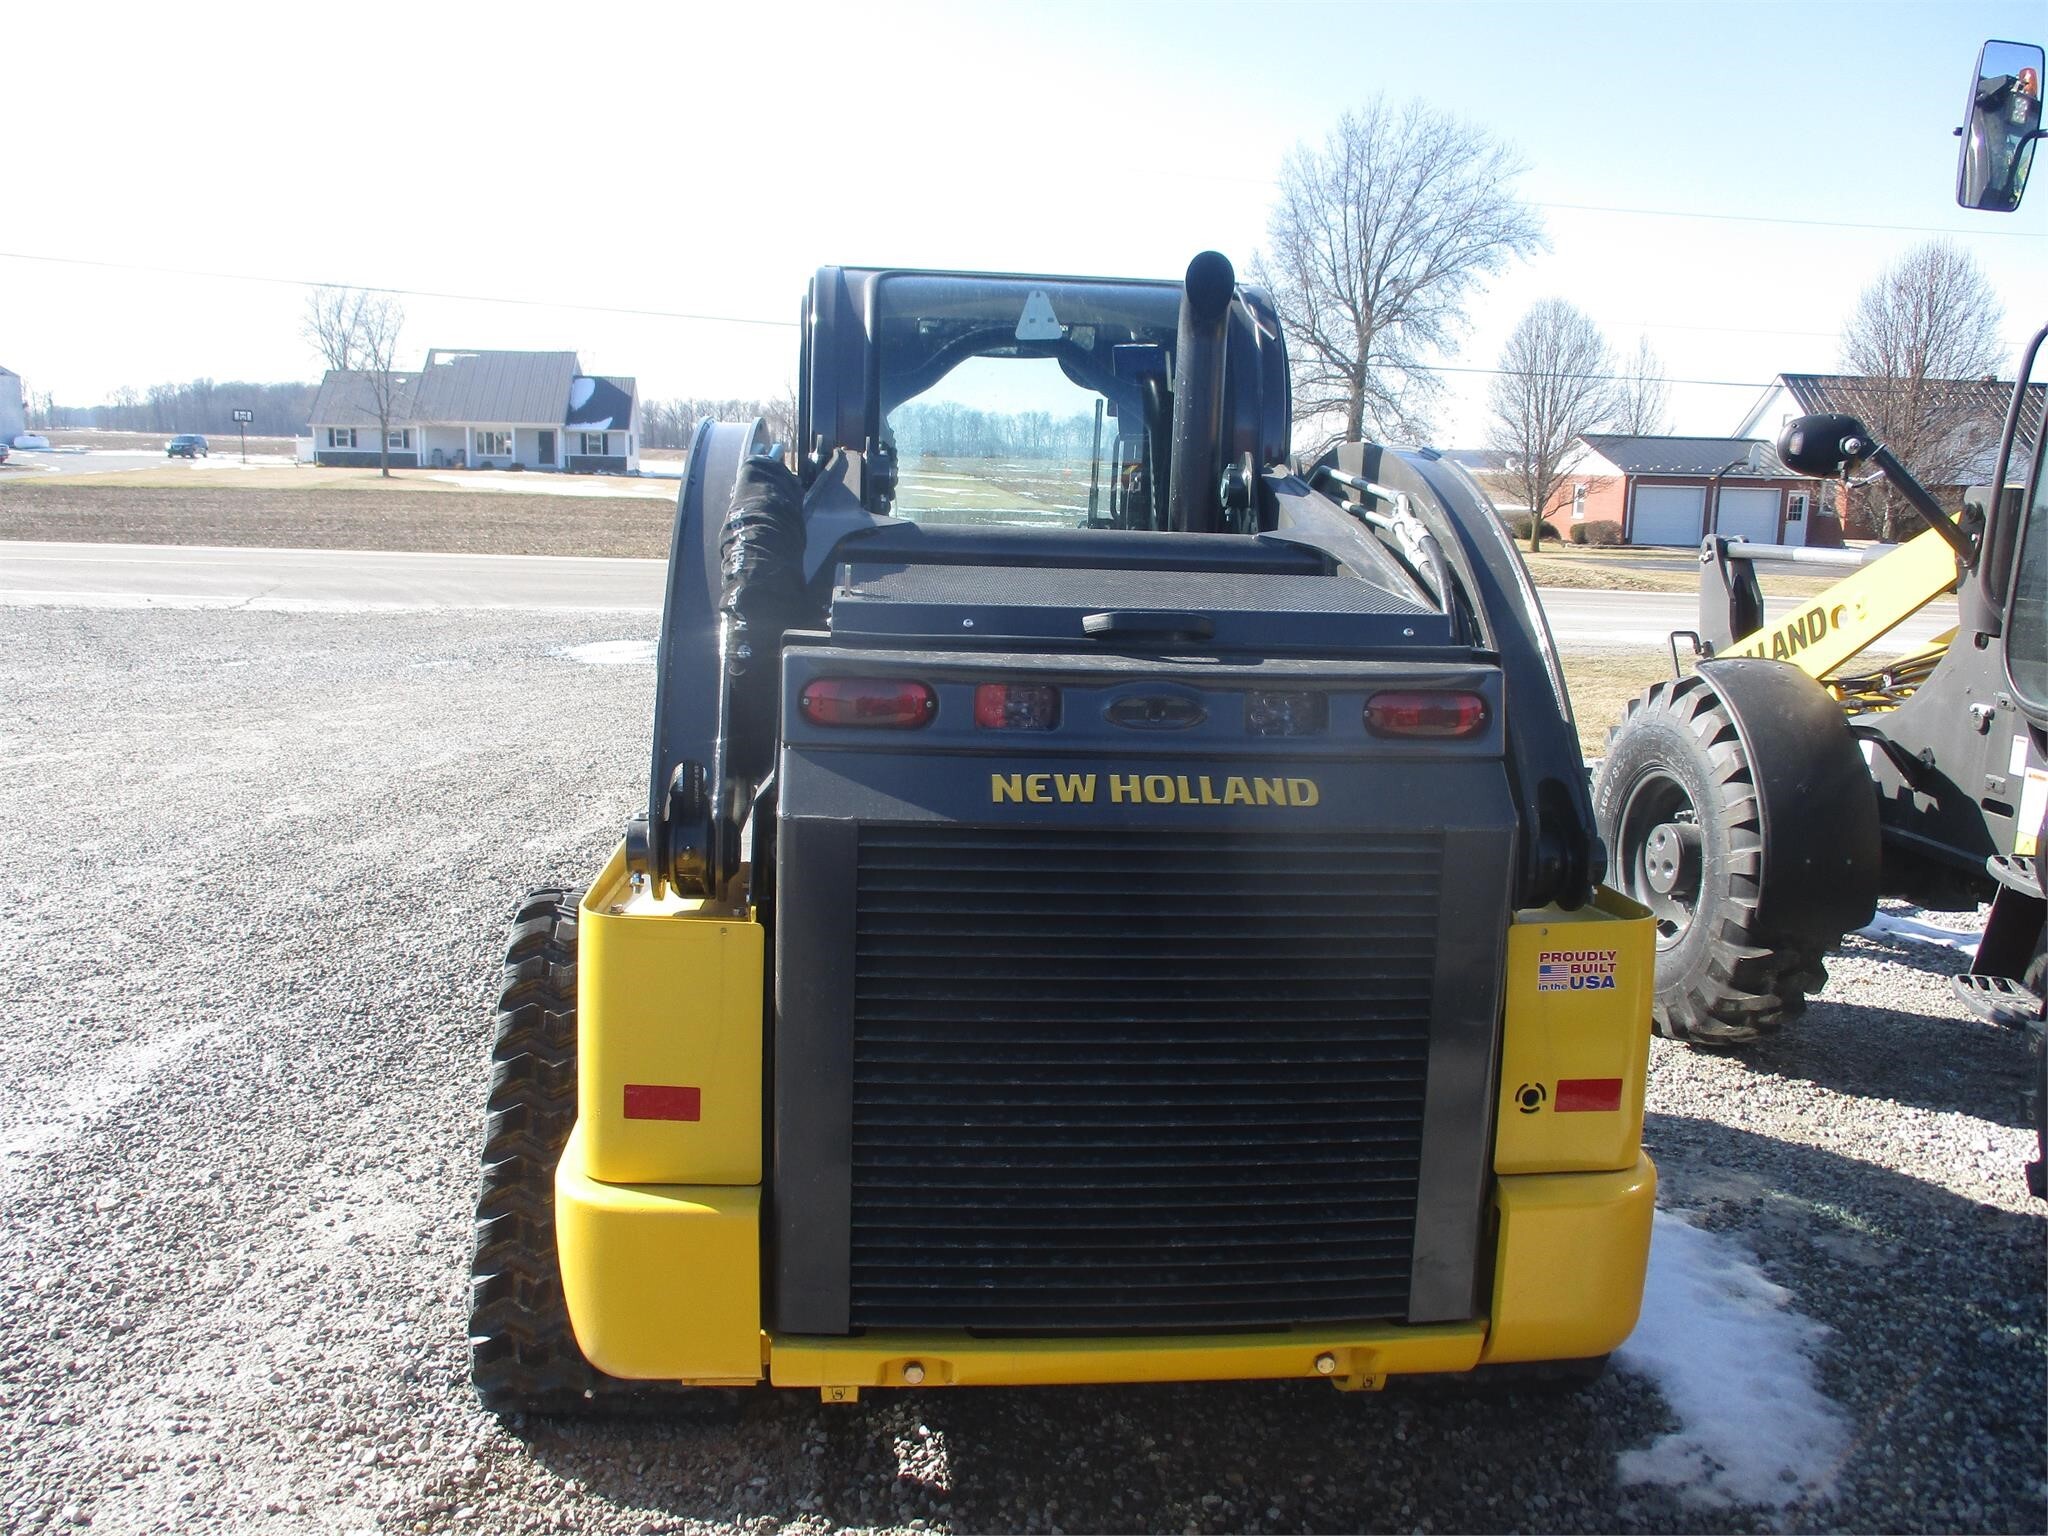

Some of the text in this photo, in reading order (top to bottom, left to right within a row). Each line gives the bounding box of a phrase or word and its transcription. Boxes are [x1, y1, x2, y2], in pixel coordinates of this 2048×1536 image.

[991, 773, 1320, 807] NEW HOLLAND
[1539, 951, 1617, 962] PROUDLY
[1570, 963, 1617, 973] BUILT
[1538, 975, 1615, 991] in the USA
